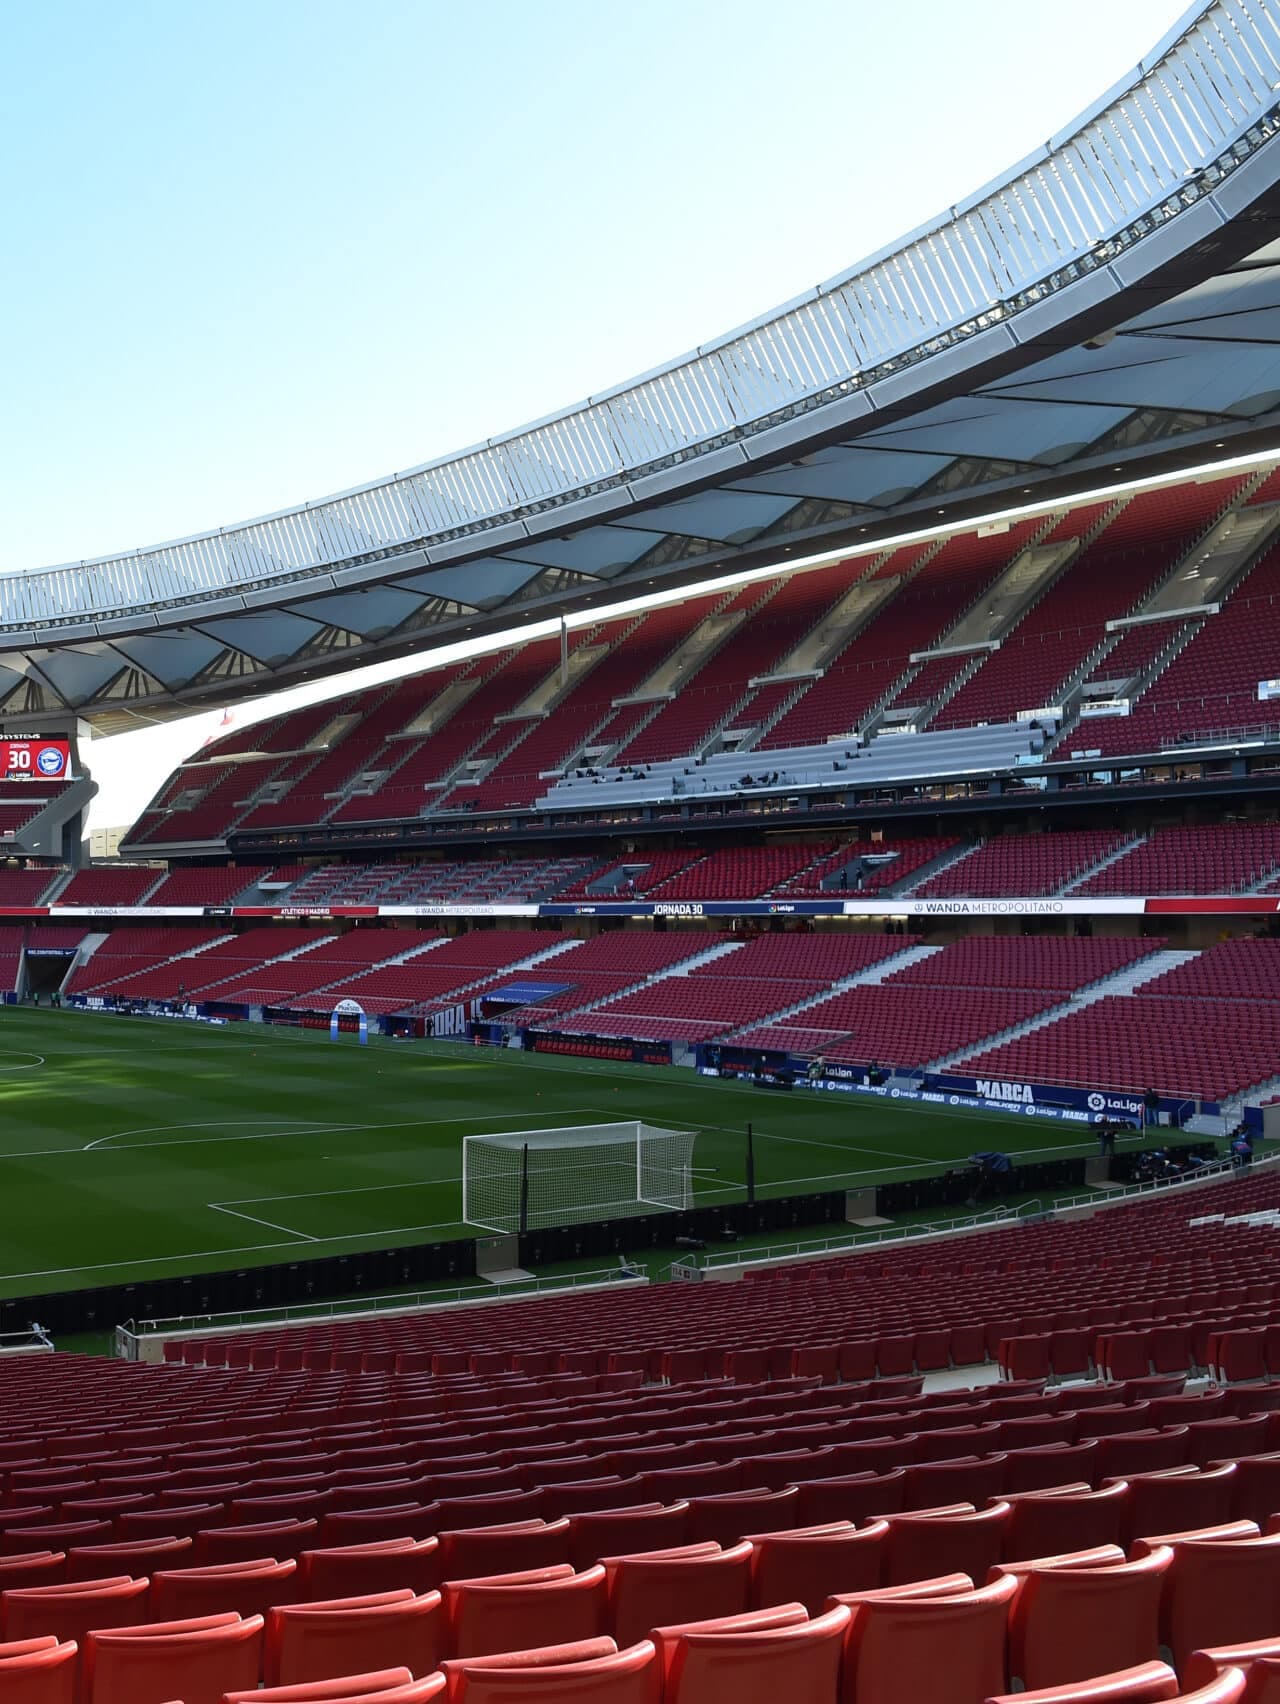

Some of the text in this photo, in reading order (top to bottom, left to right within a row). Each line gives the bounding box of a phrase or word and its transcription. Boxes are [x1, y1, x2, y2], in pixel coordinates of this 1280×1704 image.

[8, 750, 31, 769] 30
[281, 907, 304, 915] ATLÉTICO
[653, 904, 703, 915] JORNADA 30
[777, 904, 795, 912] LaLiga
[926, 902, 1064, 913] WANDA METROPOLITANO
[922, 1092, 945, 1102] MARCA
[975, 1080, 1035, 1104] MARCA
[1036, 1107, 1058, 1116] LaLiga
[1062, 1110, 1089, 1121] MARCA
